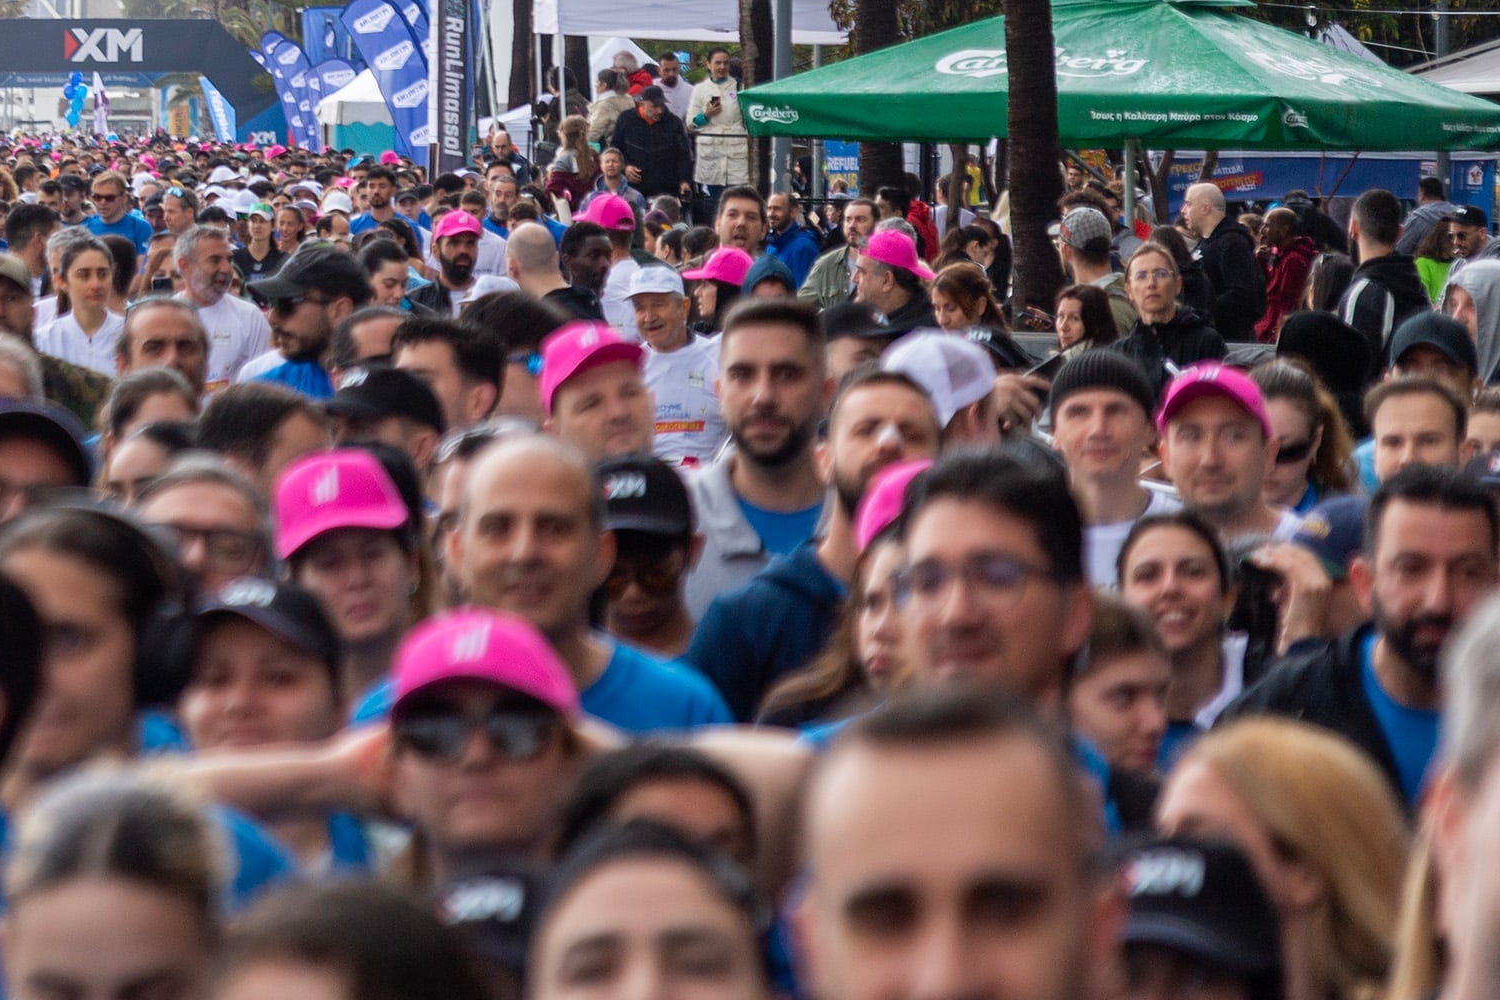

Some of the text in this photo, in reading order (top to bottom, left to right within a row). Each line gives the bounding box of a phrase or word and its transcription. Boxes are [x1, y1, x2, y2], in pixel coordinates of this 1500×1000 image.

[71, 28, 143, 62] XM
[749, 104, 799, 124] Carlsberg
[1124, 111, 1168, 122] Καλύτερη
[827, 156, 859, 171] REFUEL
